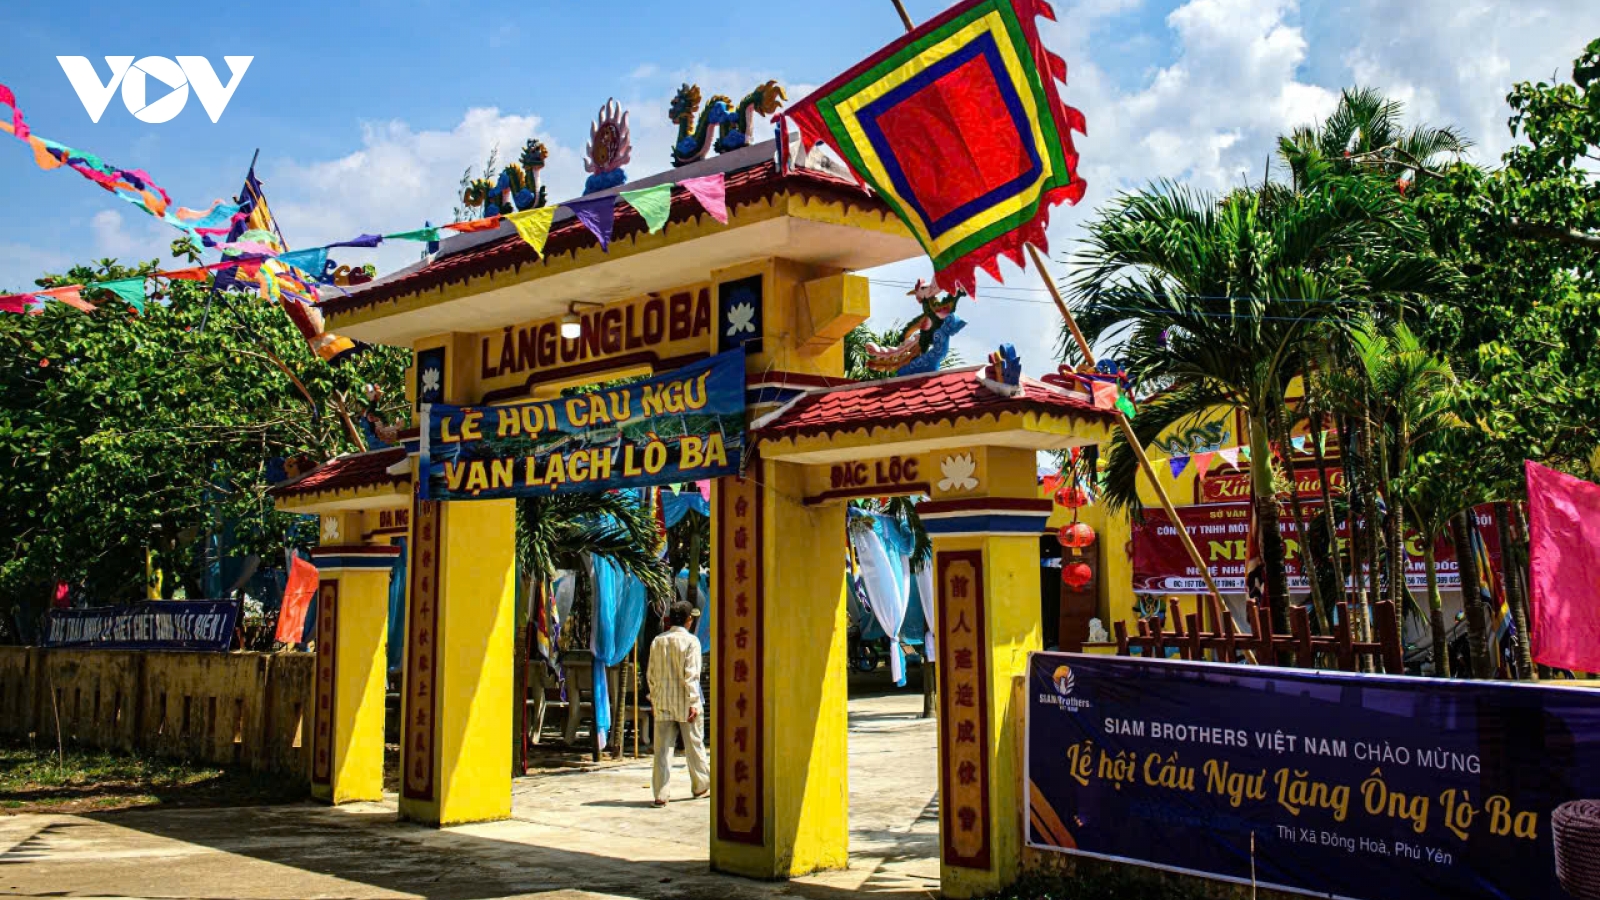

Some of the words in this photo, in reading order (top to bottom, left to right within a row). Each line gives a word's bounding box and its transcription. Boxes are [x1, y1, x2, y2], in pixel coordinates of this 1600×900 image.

[670, 287, 711, 343] BA
[643, 370, 711, 416] NGƯ
[444, 457, 514, 497] VẠN
[526, 446, 620, 492] LẠCH
[623, 432, 667, 478] LÒ
[679, 432, 728, 471] BA
[1104, 717, 1145, 737] SIAM
[1151, 721, 1248, 747] BROTHERS
[1255, 729, 1297, 755] VIỆT
[1304, 736, 1348, 758] NAM
[1354, 741, 1410, 766] CHÀO
[1417, 747, 1481, 774] MỪNG
[1066, 739, 1094, 786] Lễ
[1098, 749, 1136, 790] hội
[1143, 750, 1195, 792] Cầu
[1203, 758, 1266, 808] Ngư
[1274, 766, 1351, 823] Lăng
[1360, 766, 1429, 834] Ông
[1439, 788, 1480, 841] Lò
[1485, 795, 1539, 840] Ba
[1277, 825, 1296, 843] Thị
[1300, 828, 1317, 845] Xã
[1395, 842, 1421, 860] Phú
[1426, 847, 1453, 866] Yên
